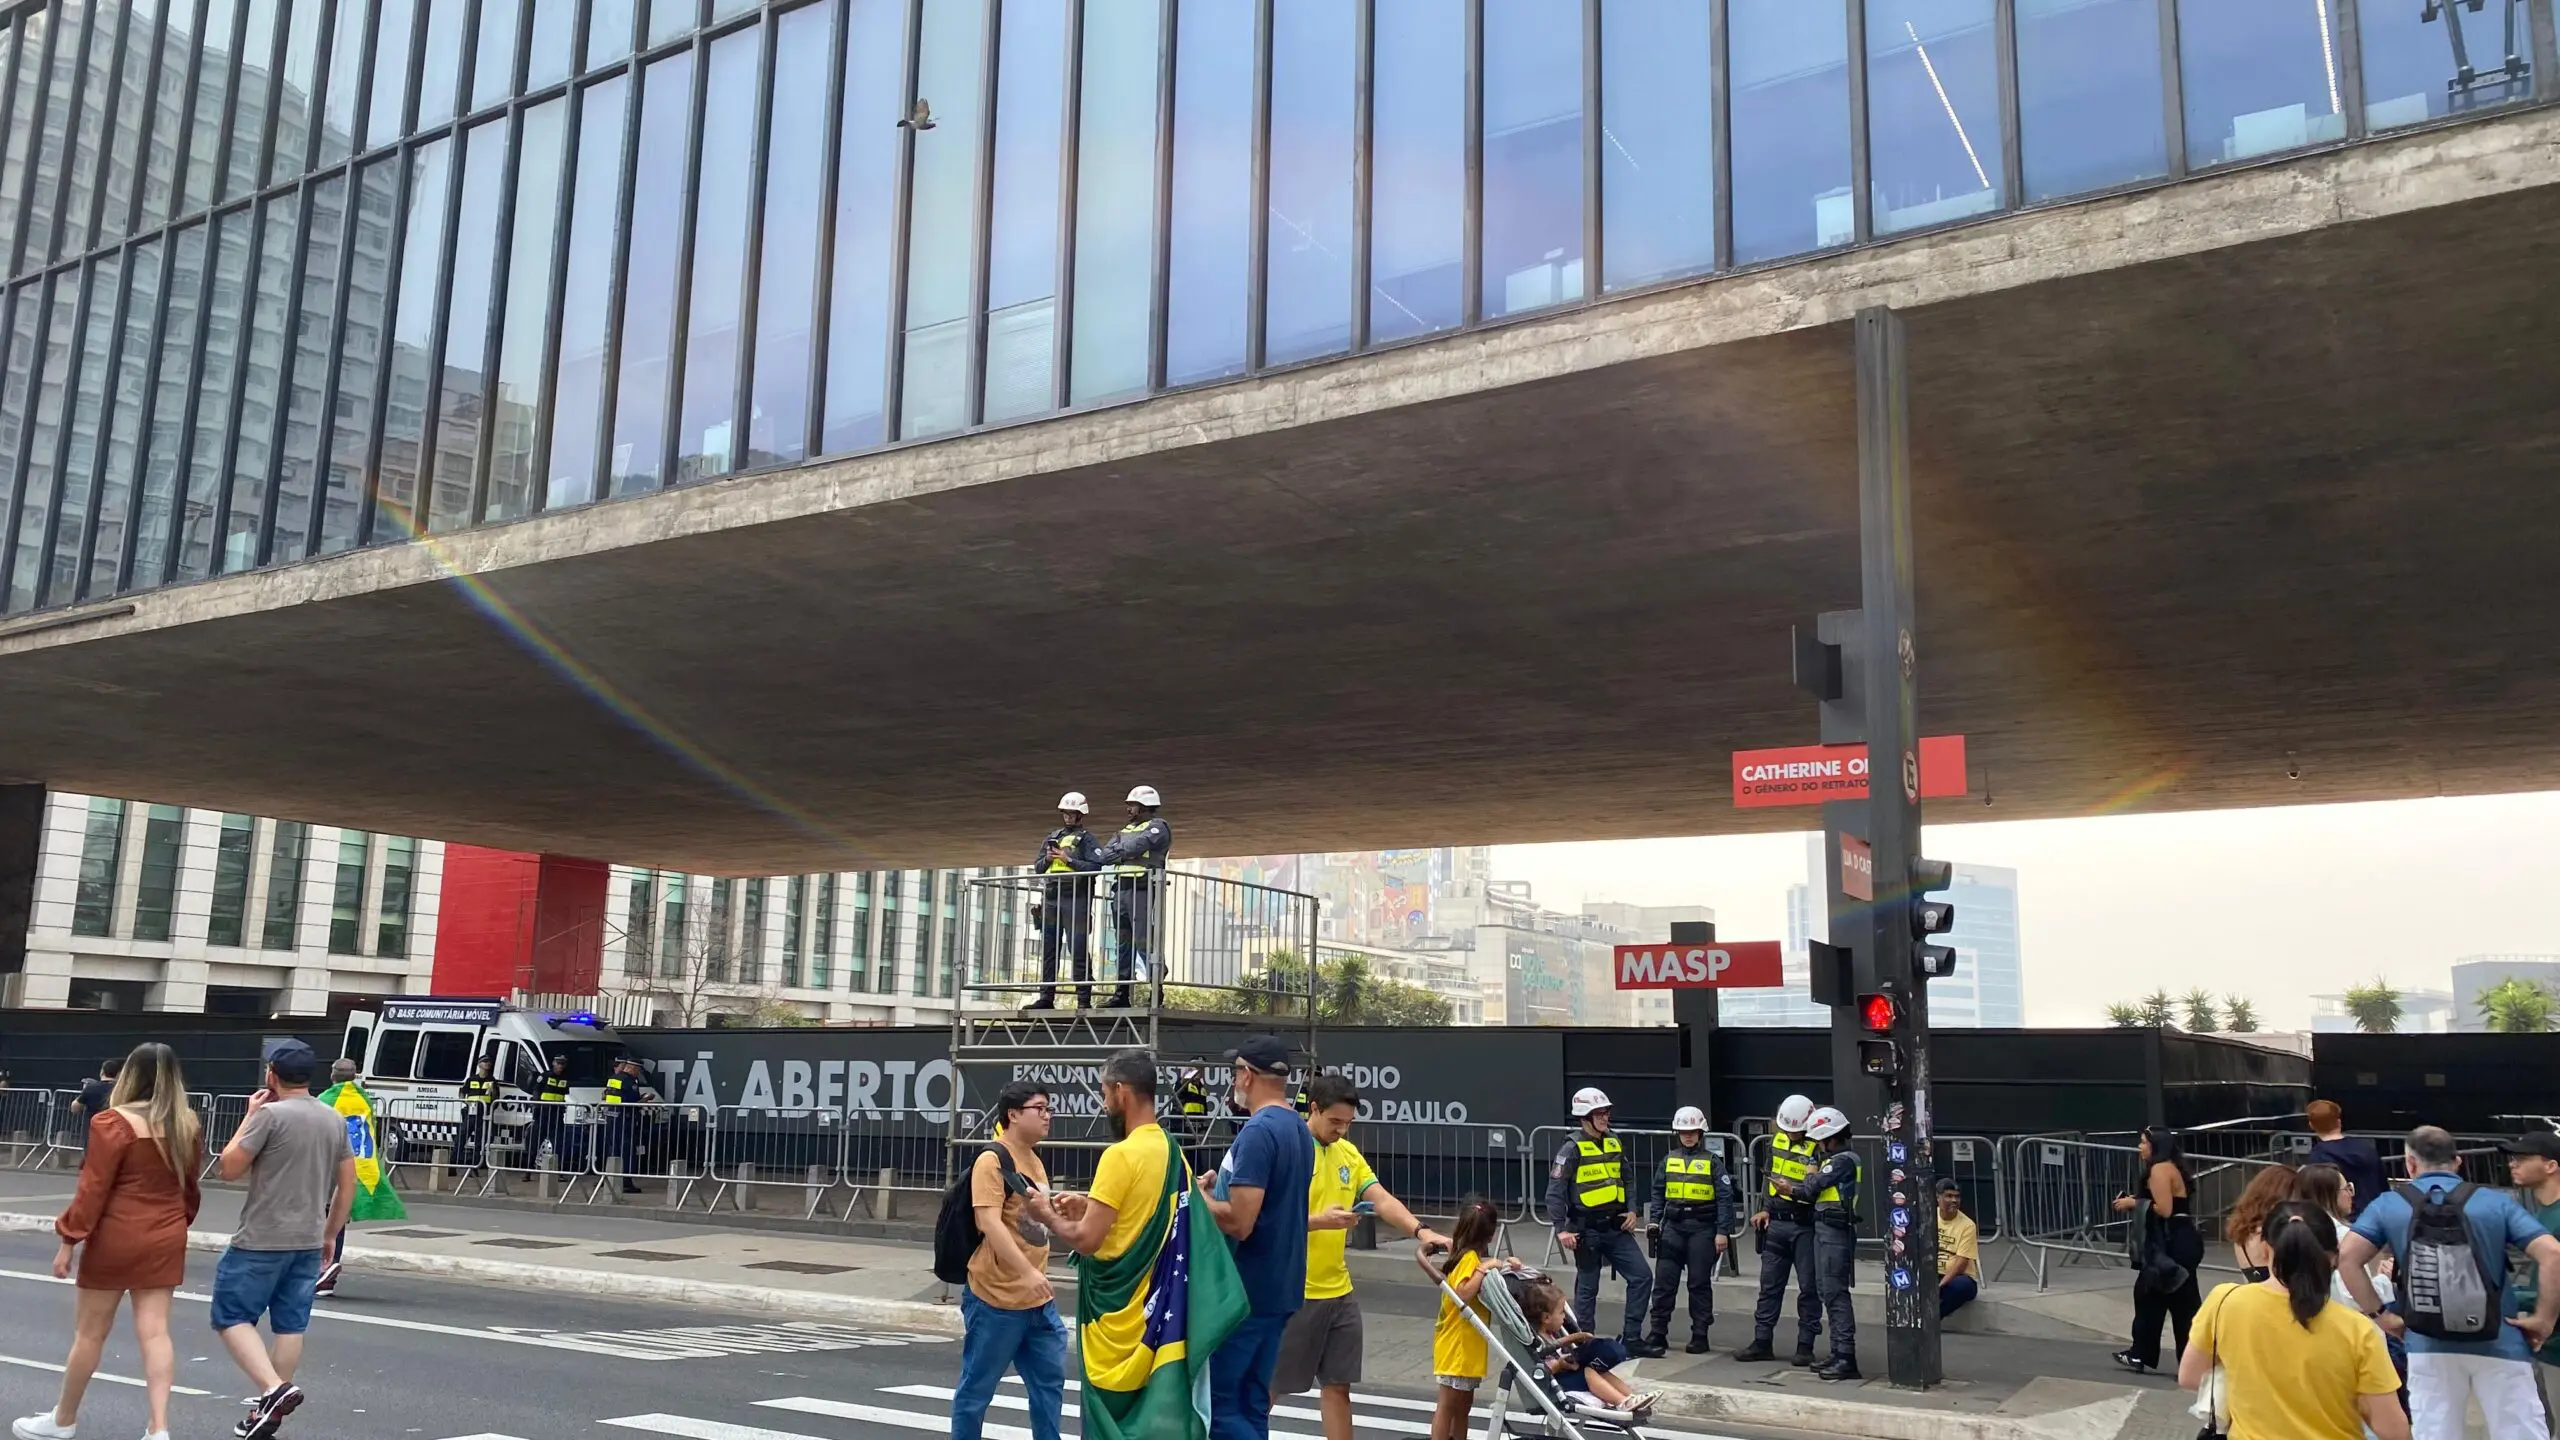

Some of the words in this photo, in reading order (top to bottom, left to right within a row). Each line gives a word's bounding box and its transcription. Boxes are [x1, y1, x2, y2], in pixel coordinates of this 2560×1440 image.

[1741, 760, 1842, 782] CATHERINE
[1847, 758, 1869, 775] O
[1742, 786, 1752, 795] O
[1755, 782, 1798, 795] GÊNERO
[1801, 781, 1818, 792] DO
[1821, 778, 1869, 790] RETRATO
[1621, 949, 1731, 984] MASP
[396, 1008, 416, 1019] BASE
[416, 1008, 464, 1020] COMUNITÁRIA
[464, 1009, 491, 1021] MÓVEL
[1012, 1064, 1103, 1085] ENQUAN
[737, 1059, 966, 1124] ABERTO
[1381, 1100, 1468, 1124] PAULO
